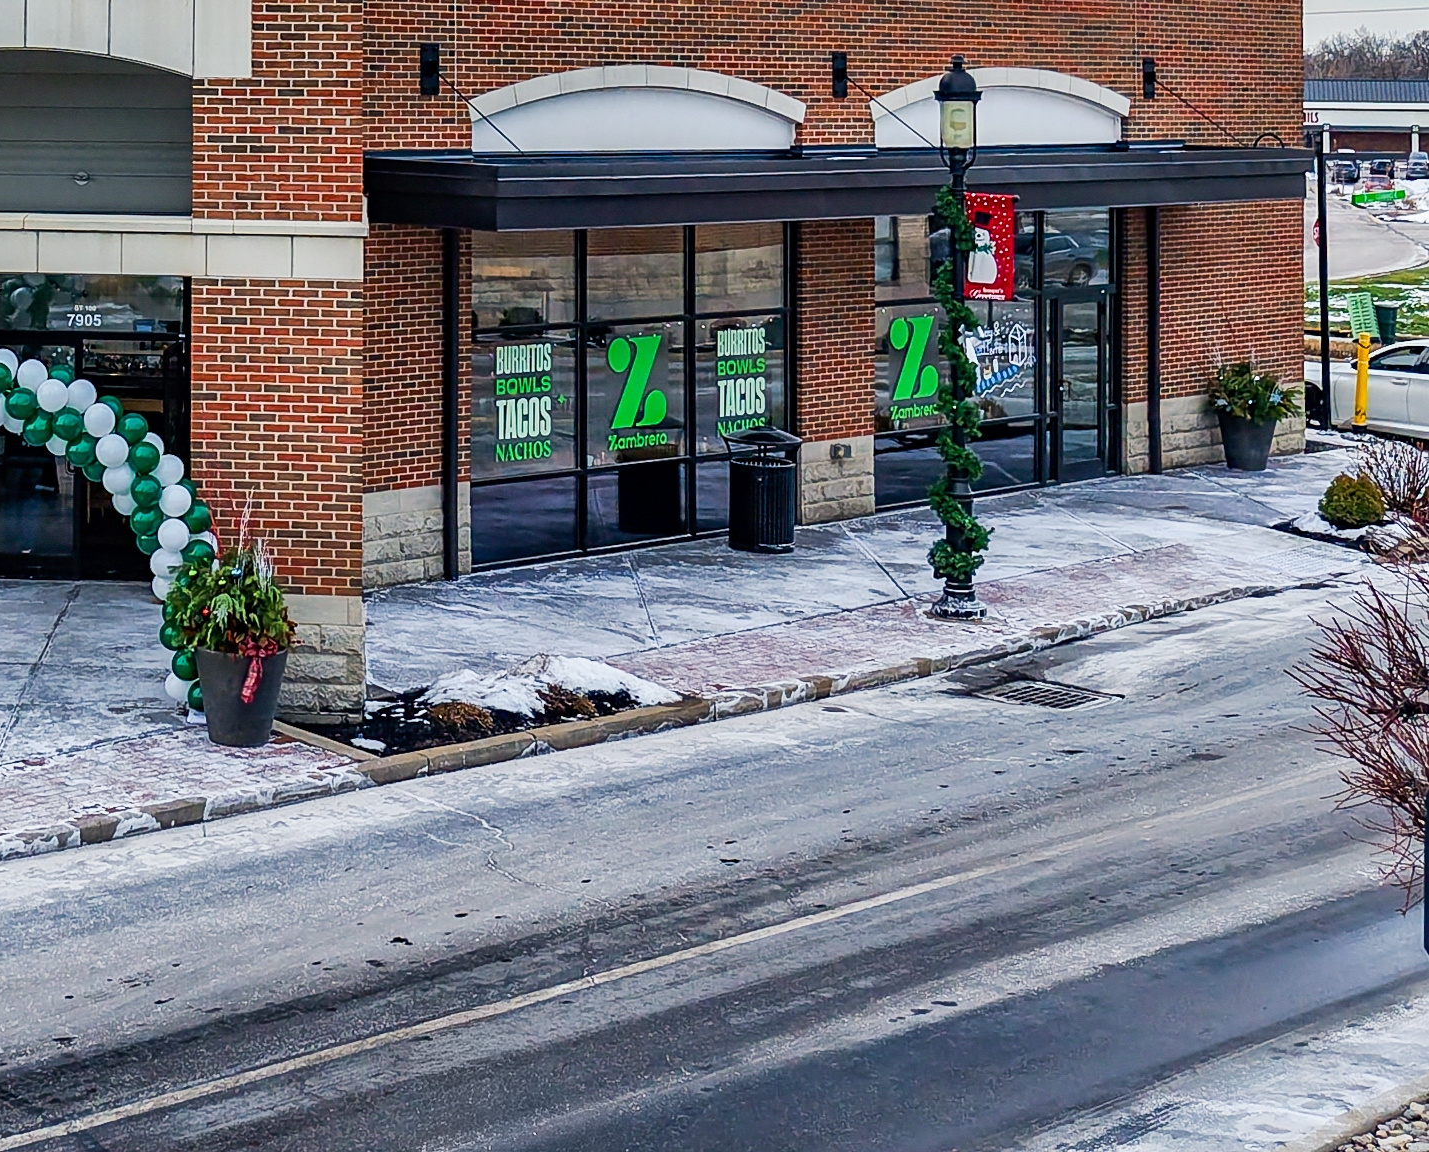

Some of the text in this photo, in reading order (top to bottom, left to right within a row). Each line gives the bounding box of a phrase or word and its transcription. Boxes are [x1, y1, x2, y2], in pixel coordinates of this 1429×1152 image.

[67, 313, 102, 327] 7905
[717, 327, 766, 358] BURRITOS
[496, 343, 552, 375] BURRITOS
[717, 357, 766, 376] BOWLS
[496, 375, 552, 396] BOWLS
[717, 376, 766, 418] TACOS
[496, 396, 552, 440] TACOS
[495, 440, 552, 463] NACHOS
[608, 432, 668, 452] Zambrero
